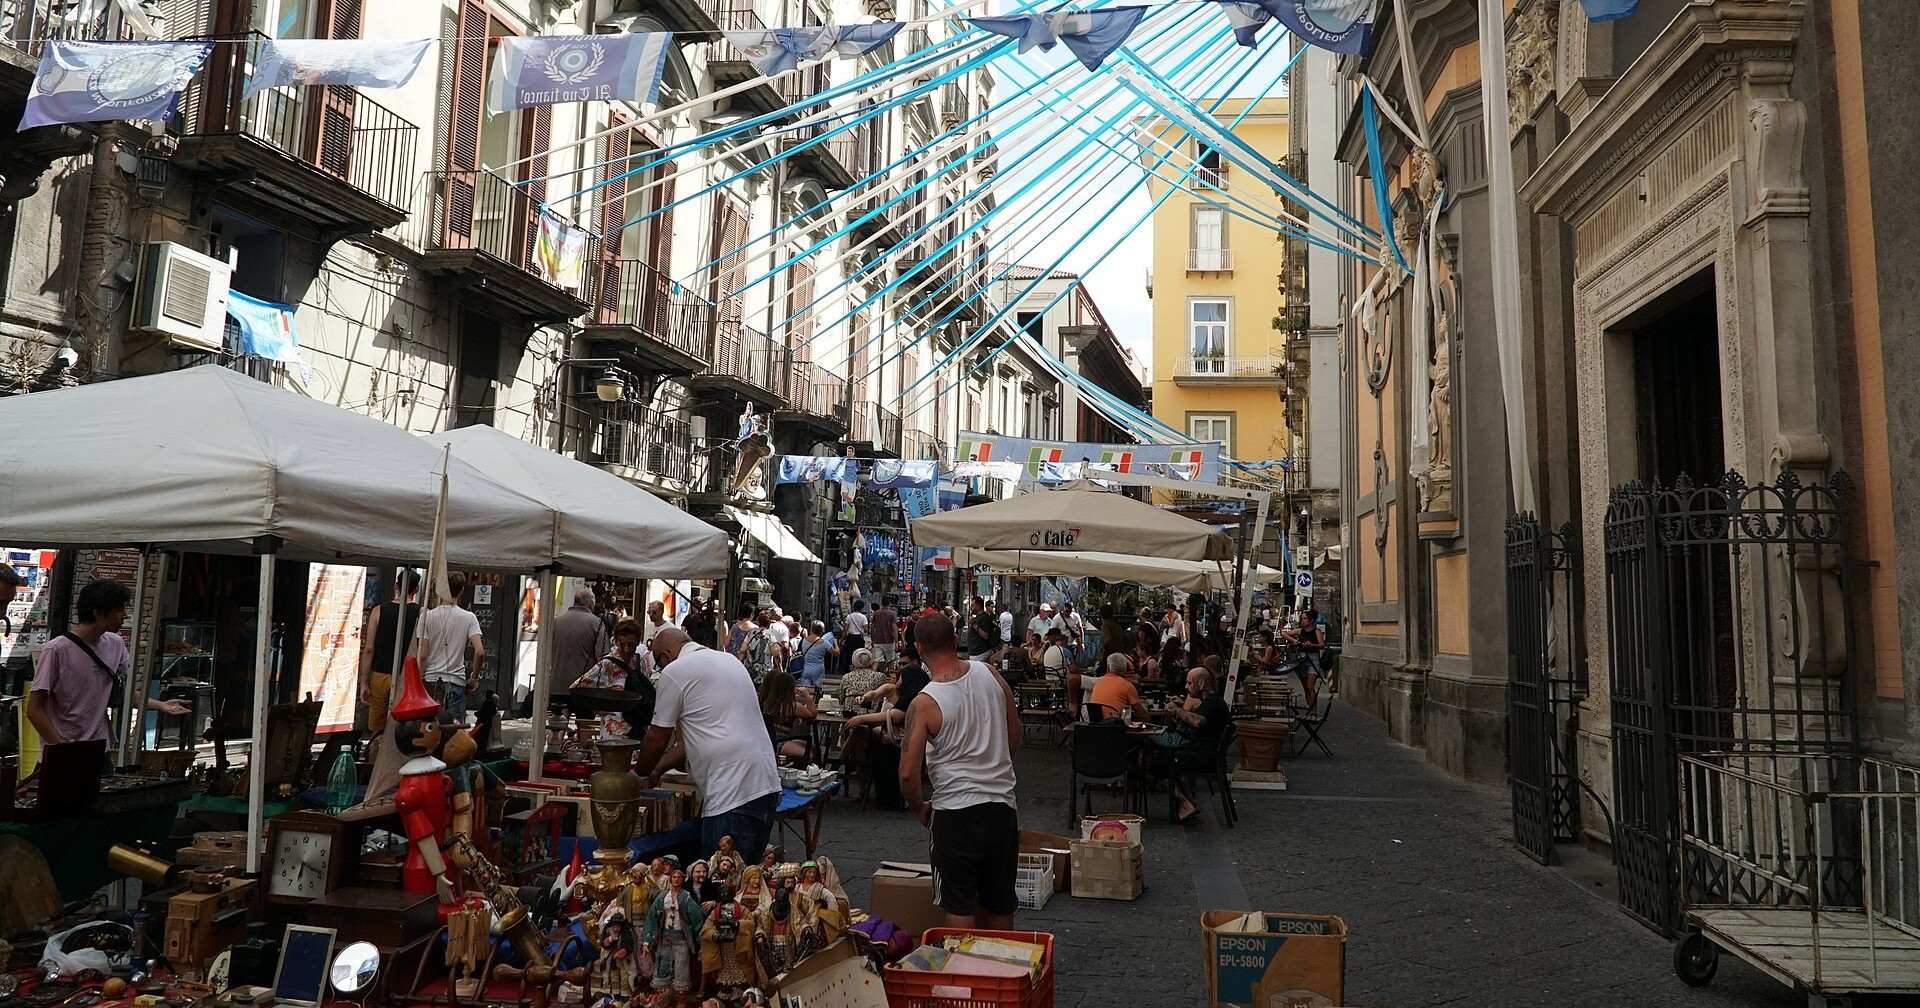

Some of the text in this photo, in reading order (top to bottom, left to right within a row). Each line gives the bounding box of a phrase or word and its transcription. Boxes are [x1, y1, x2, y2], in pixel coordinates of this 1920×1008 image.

[1278, 920, 1325, 934] EPSON
[1219, 937, 1266, 952] EPSON
[1219, 954, 1266, 969] EPL-5800
